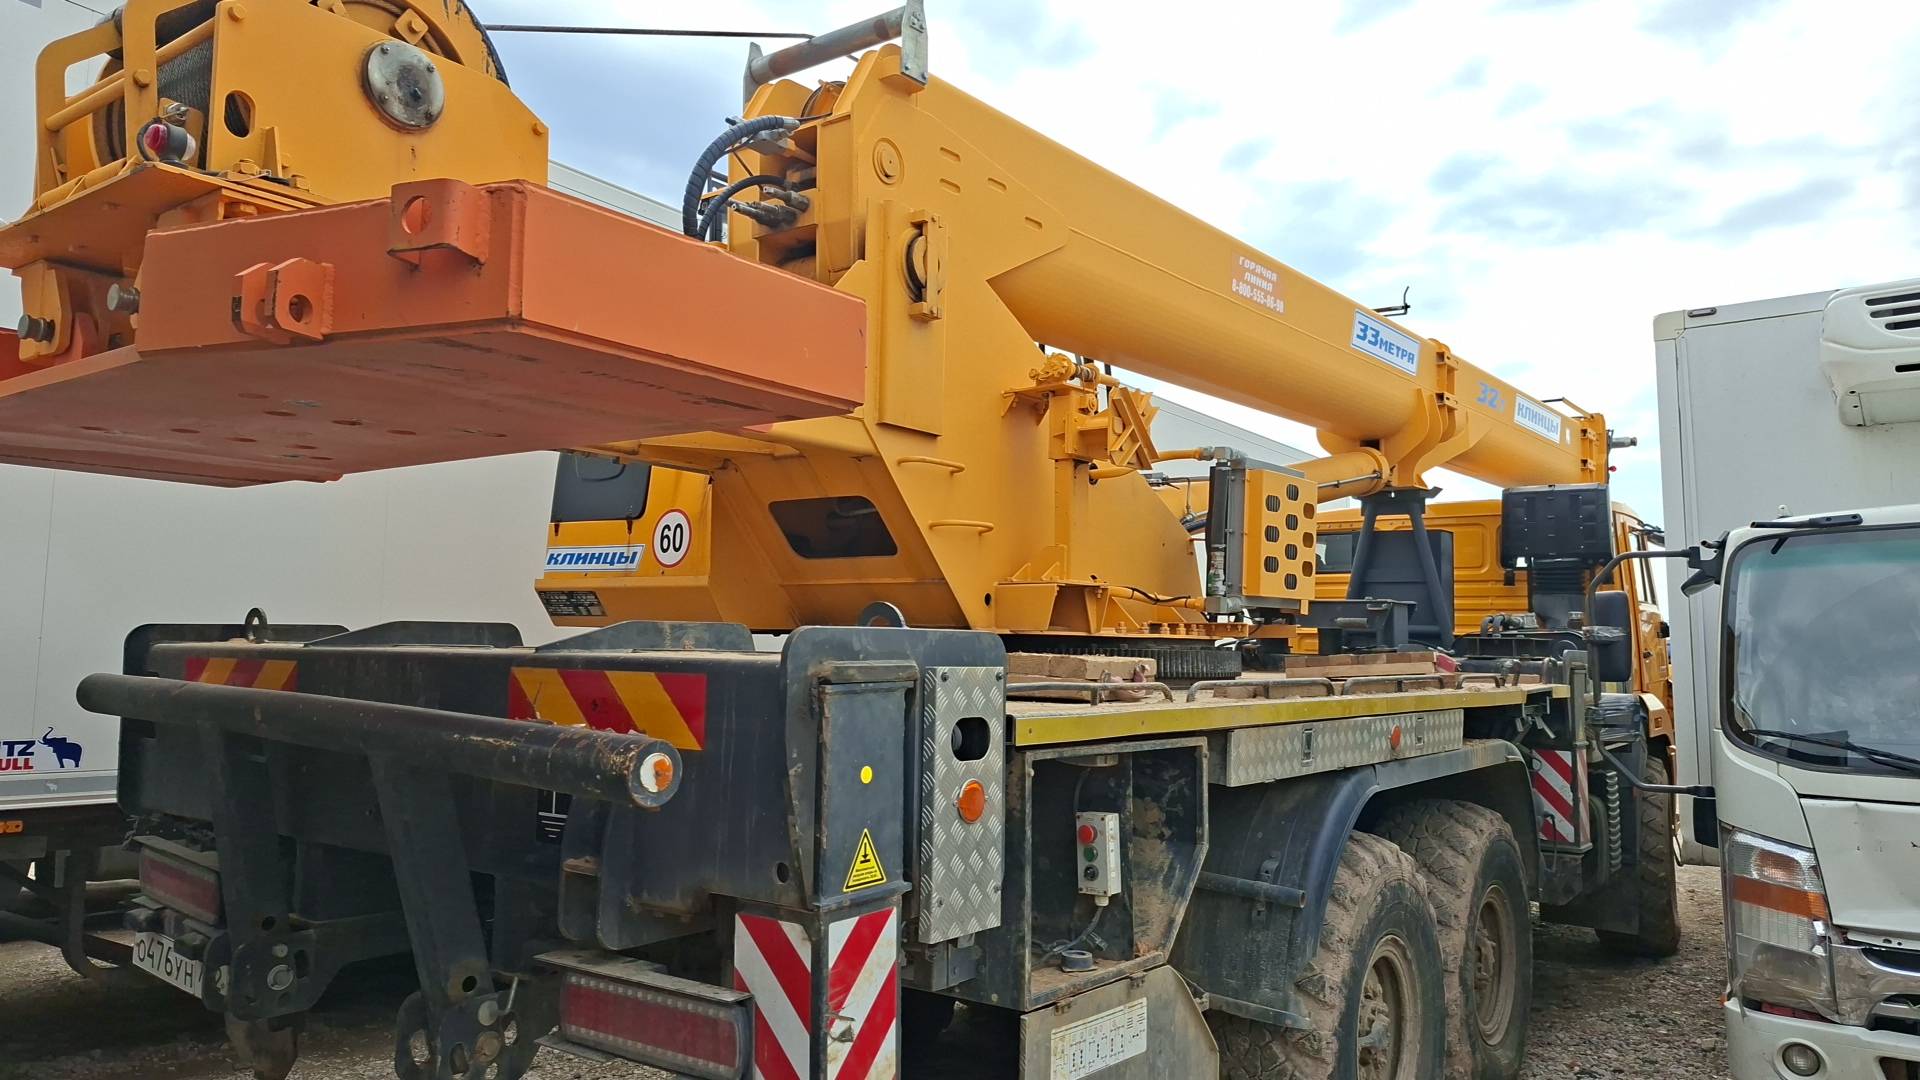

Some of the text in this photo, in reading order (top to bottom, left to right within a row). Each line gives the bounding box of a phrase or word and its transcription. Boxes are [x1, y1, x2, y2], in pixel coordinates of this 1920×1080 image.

[1244, 271, 1273, 293] ЛИНИЯ
[1517, 402, 1559, 435] КЛИНЦЫ
[660, 523, 684, 553] 60
[546, 551, 638, 566] КЛИНЦЫ
[0, 740, 36, 757] TZ
